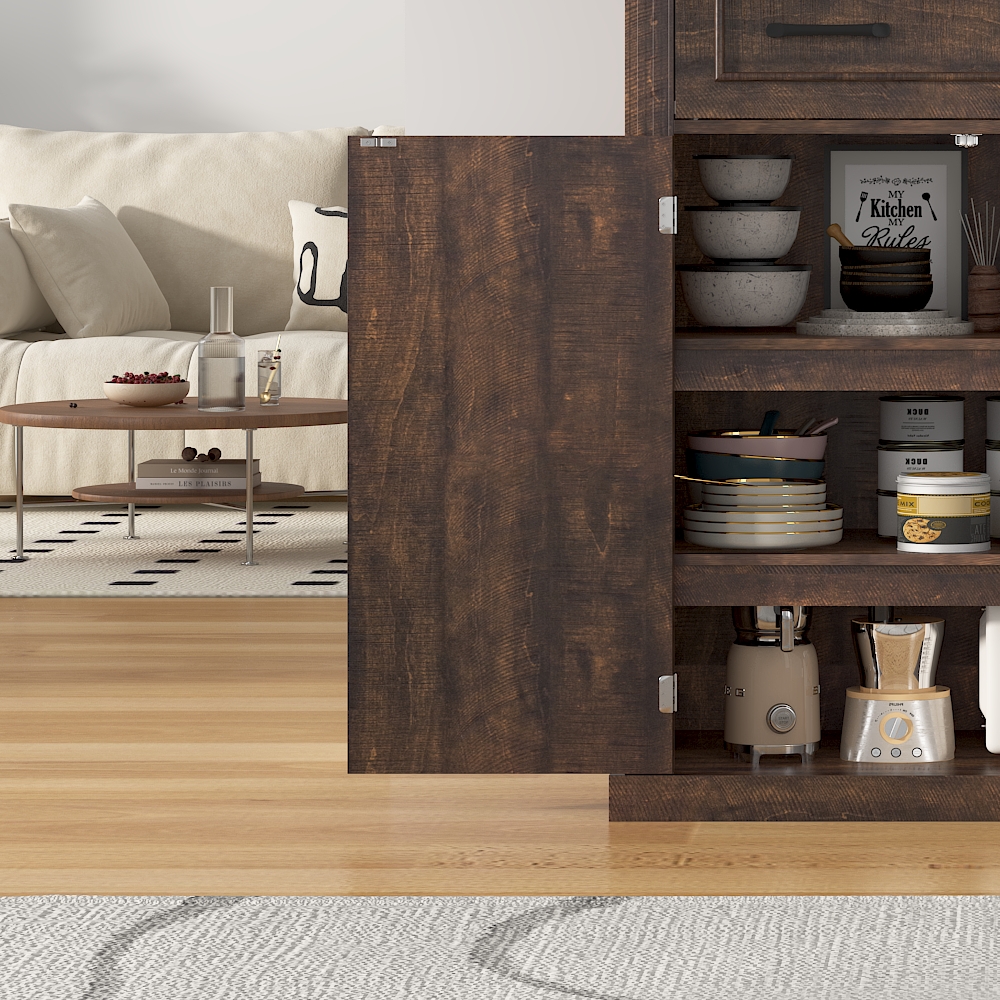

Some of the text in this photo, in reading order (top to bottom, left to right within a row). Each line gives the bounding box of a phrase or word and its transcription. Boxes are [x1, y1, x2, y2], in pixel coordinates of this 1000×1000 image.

[888, 190, 904, 198] MY
[870, 199, 922, 218] Kitchen
[861, 225, 931, 249] Rules
